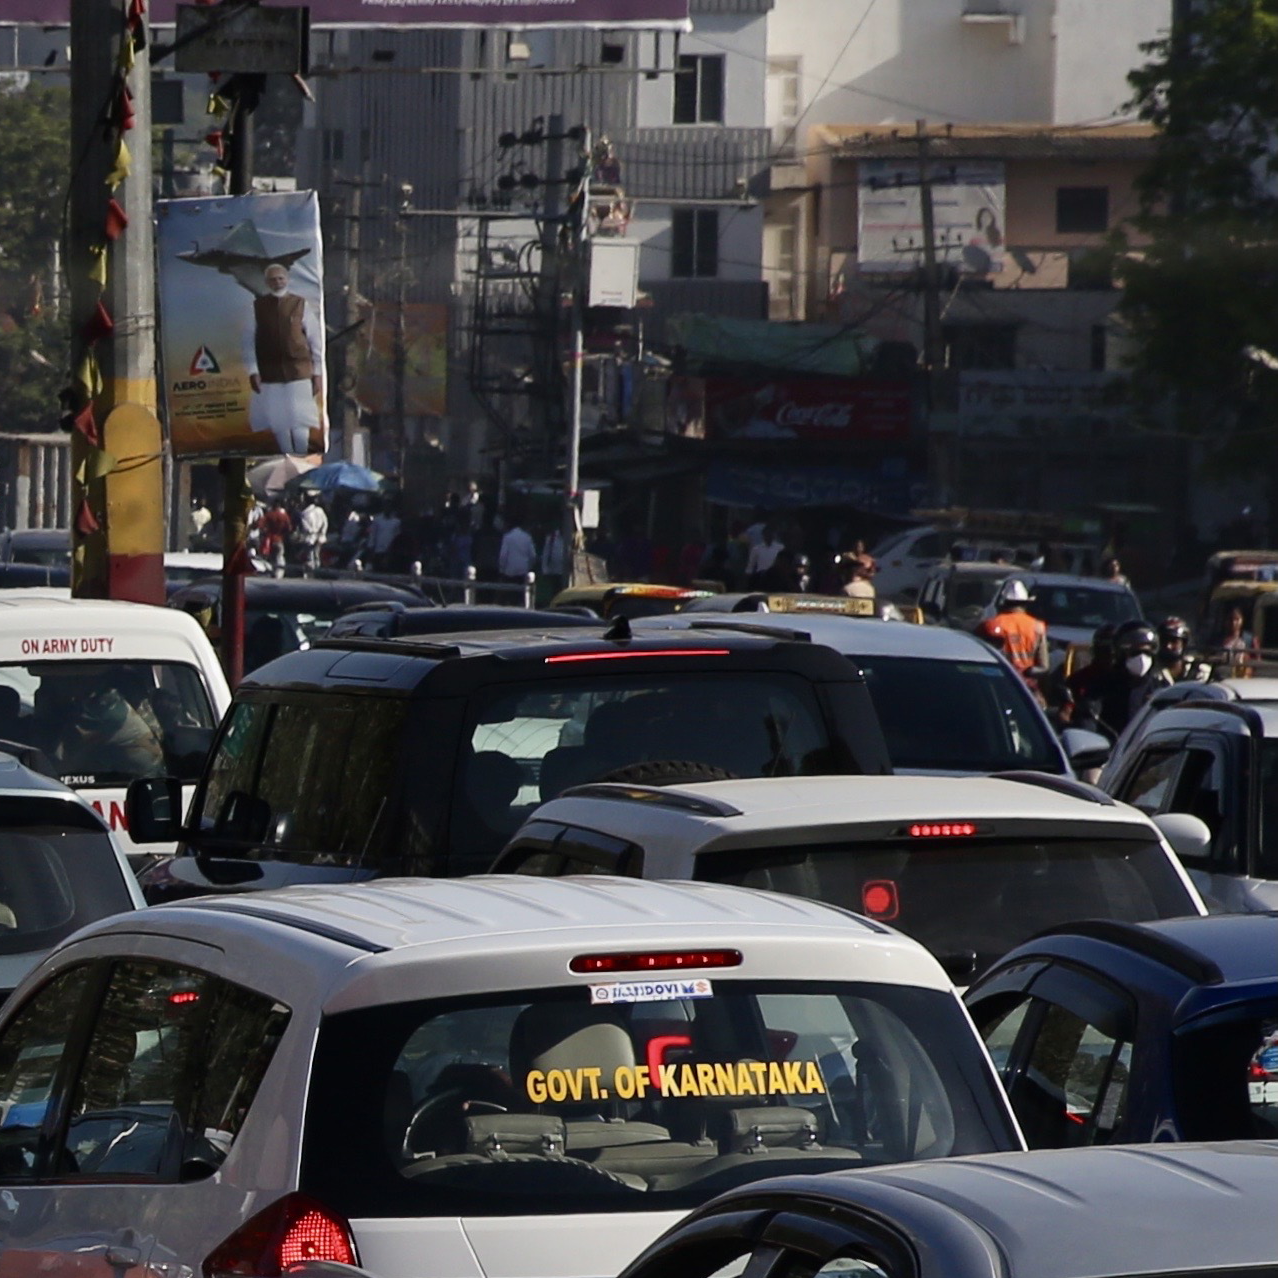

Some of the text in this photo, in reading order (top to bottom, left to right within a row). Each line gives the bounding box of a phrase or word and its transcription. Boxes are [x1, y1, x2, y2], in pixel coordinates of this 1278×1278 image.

[173, 380, 206, 392] AERO
[22, 637, 115, 655] ON ARMY DUTY
[60, 775, 96, 785] EXUS
[525, 1060, 825, 1104] GOVT. OF KARNATAKA
